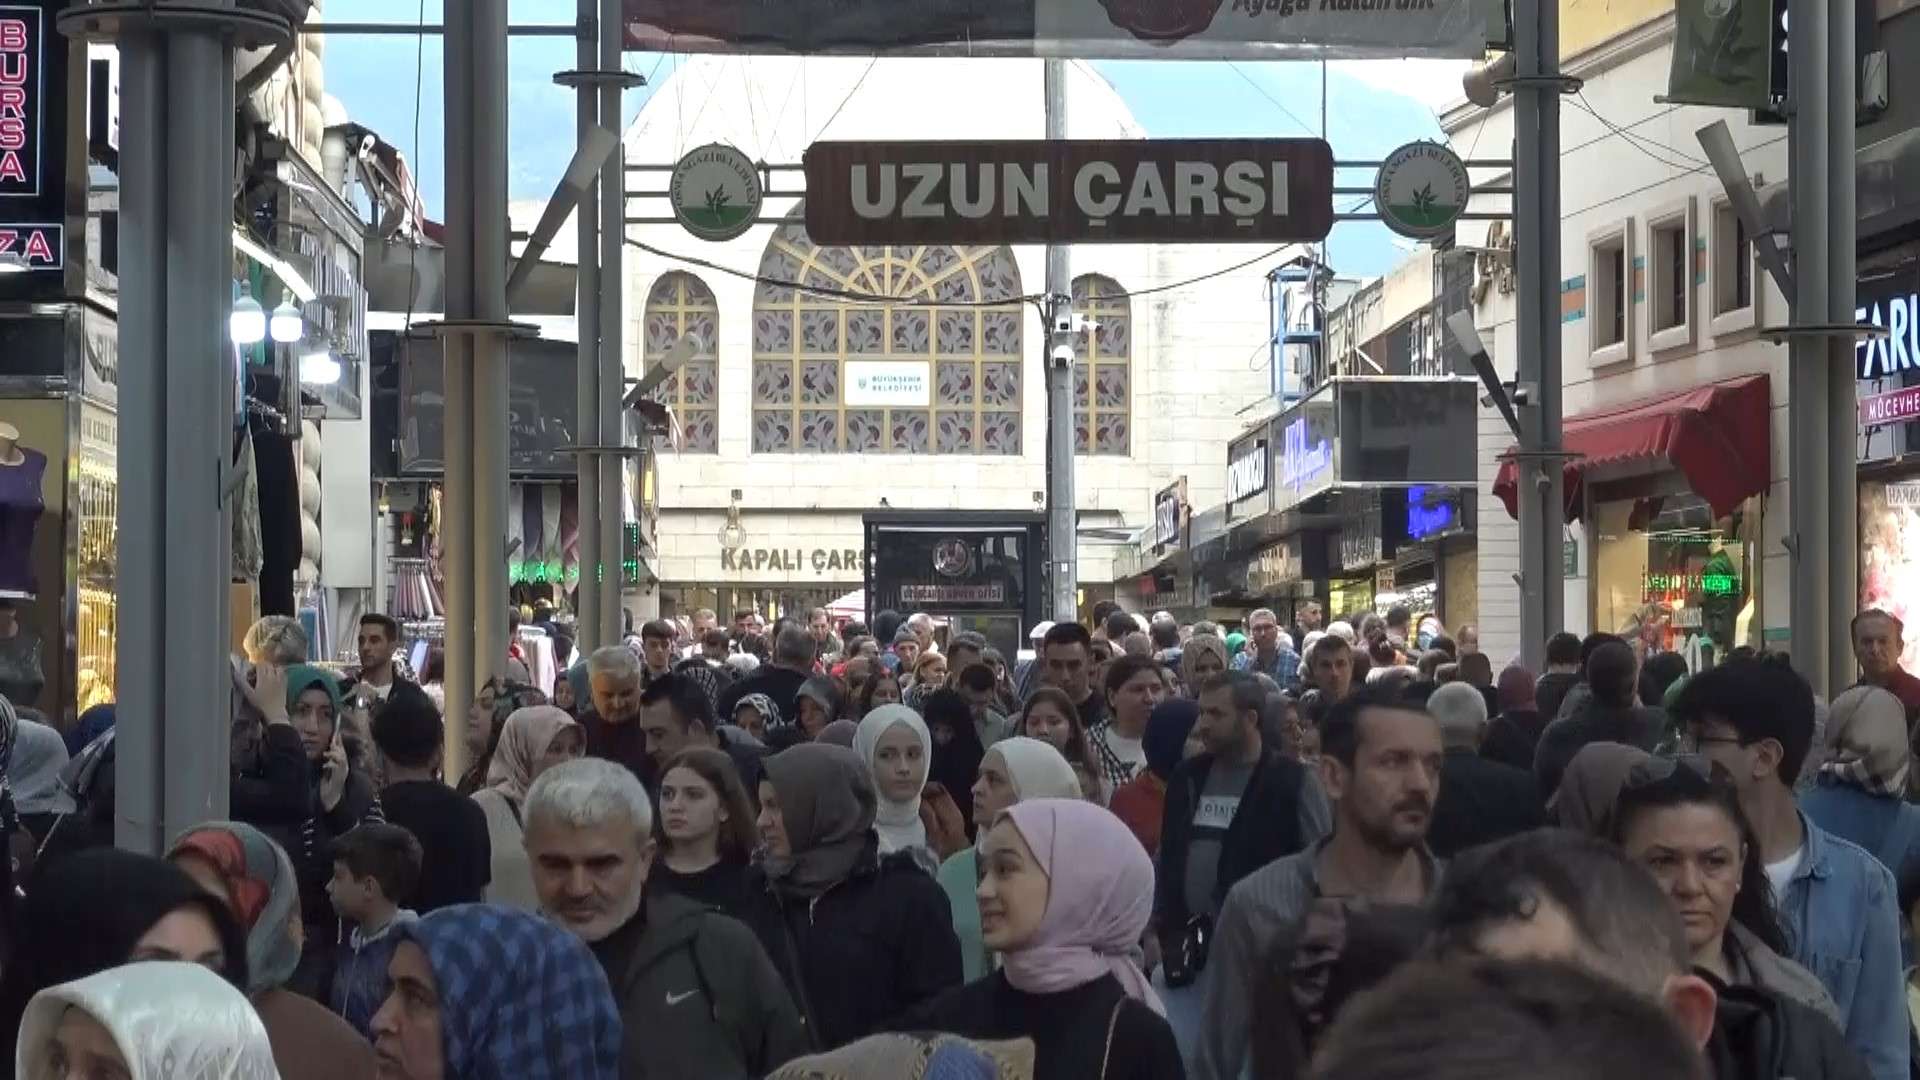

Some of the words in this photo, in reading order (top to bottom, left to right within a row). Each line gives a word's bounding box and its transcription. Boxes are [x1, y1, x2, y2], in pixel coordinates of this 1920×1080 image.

[0, 19, 27, 183] BURSA
[850, 163, 1050, 218] UZUN
[1073, 160, 1289, 226] ÇARŞI
[721, 548, 802, 571] KAPALI
